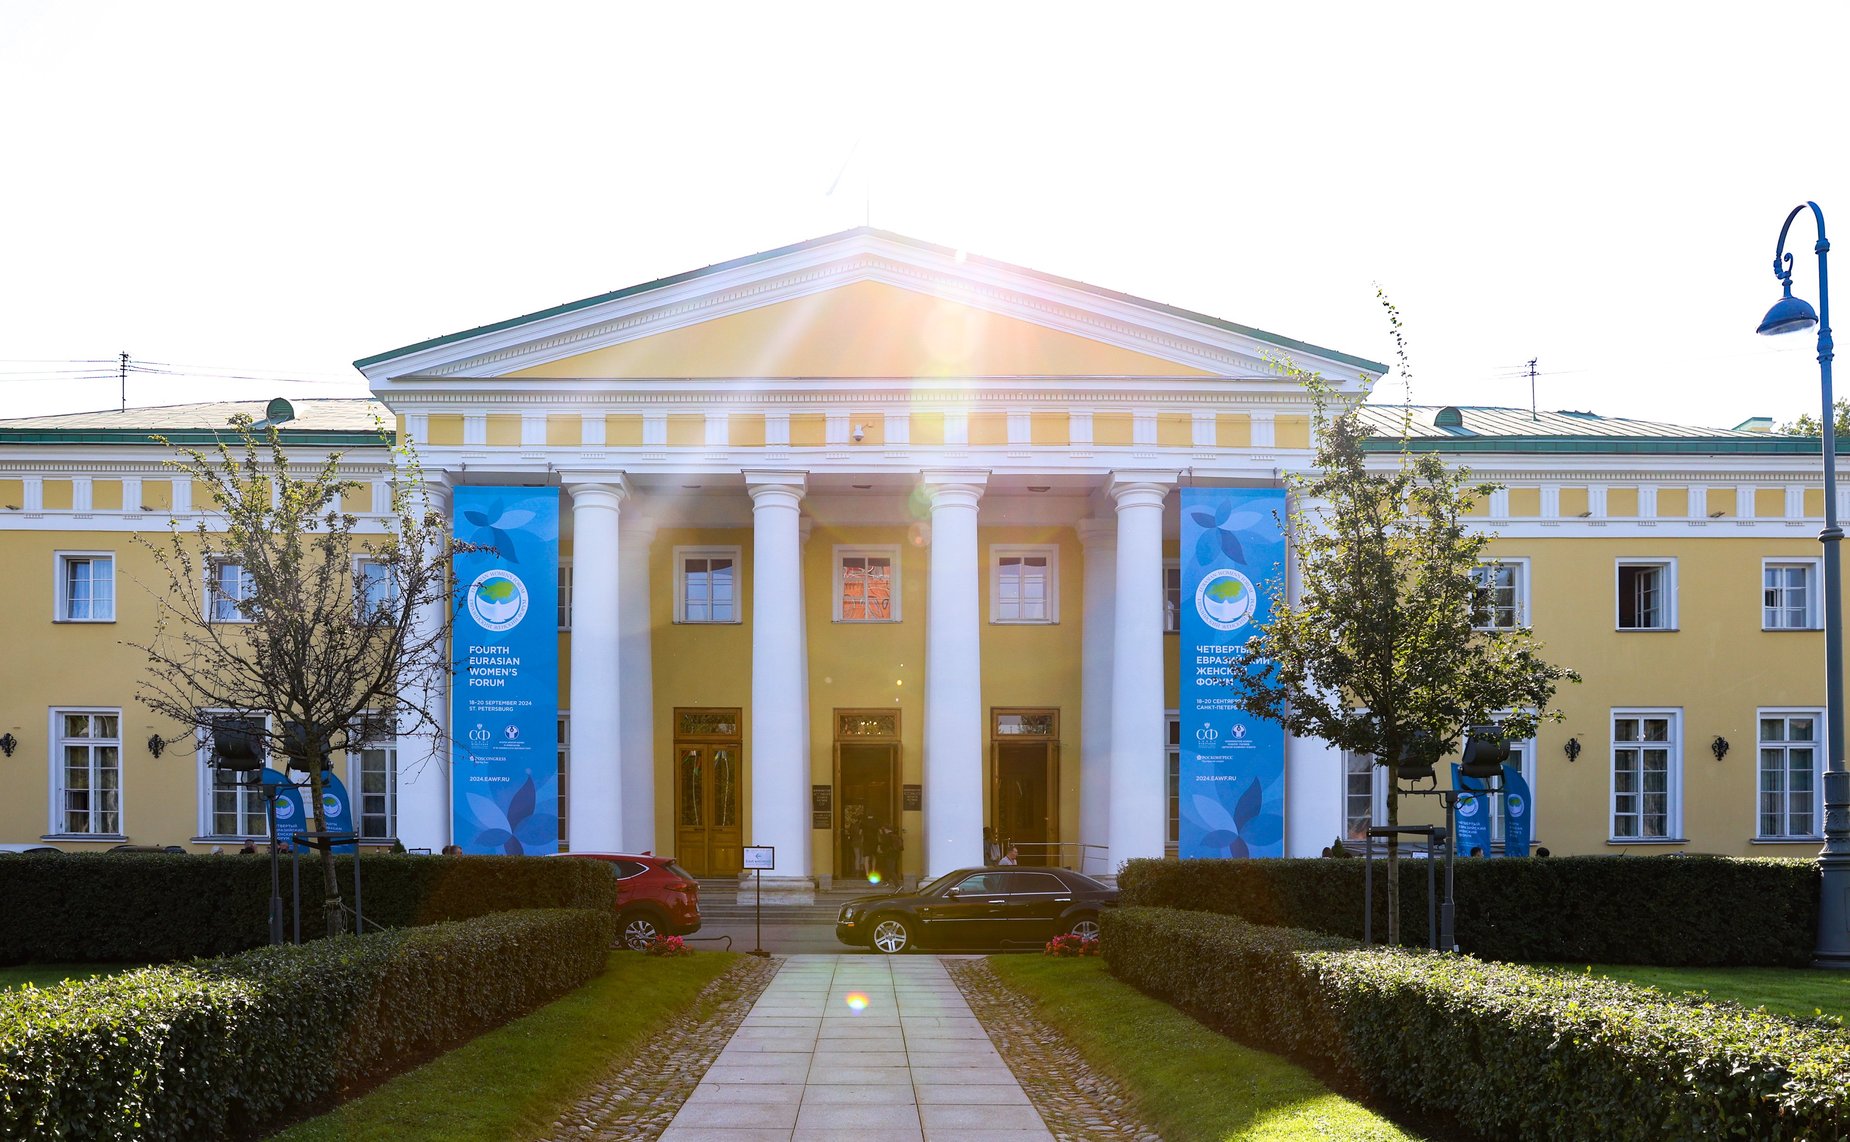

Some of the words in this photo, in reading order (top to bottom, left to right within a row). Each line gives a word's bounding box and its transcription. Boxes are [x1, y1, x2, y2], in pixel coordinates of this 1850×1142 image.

[469, 646, 509, 654] FOURTH
[1196, 645, 1254, 653] ЧЕТВЕРТЫ
[469, 657, 520, 665] EURASIAN
[469, 668, 518, 676] WOMEN'S
[469, 679, 505, 687] FORUM
[1196, 678, 1233, 686] ФОРУМ
